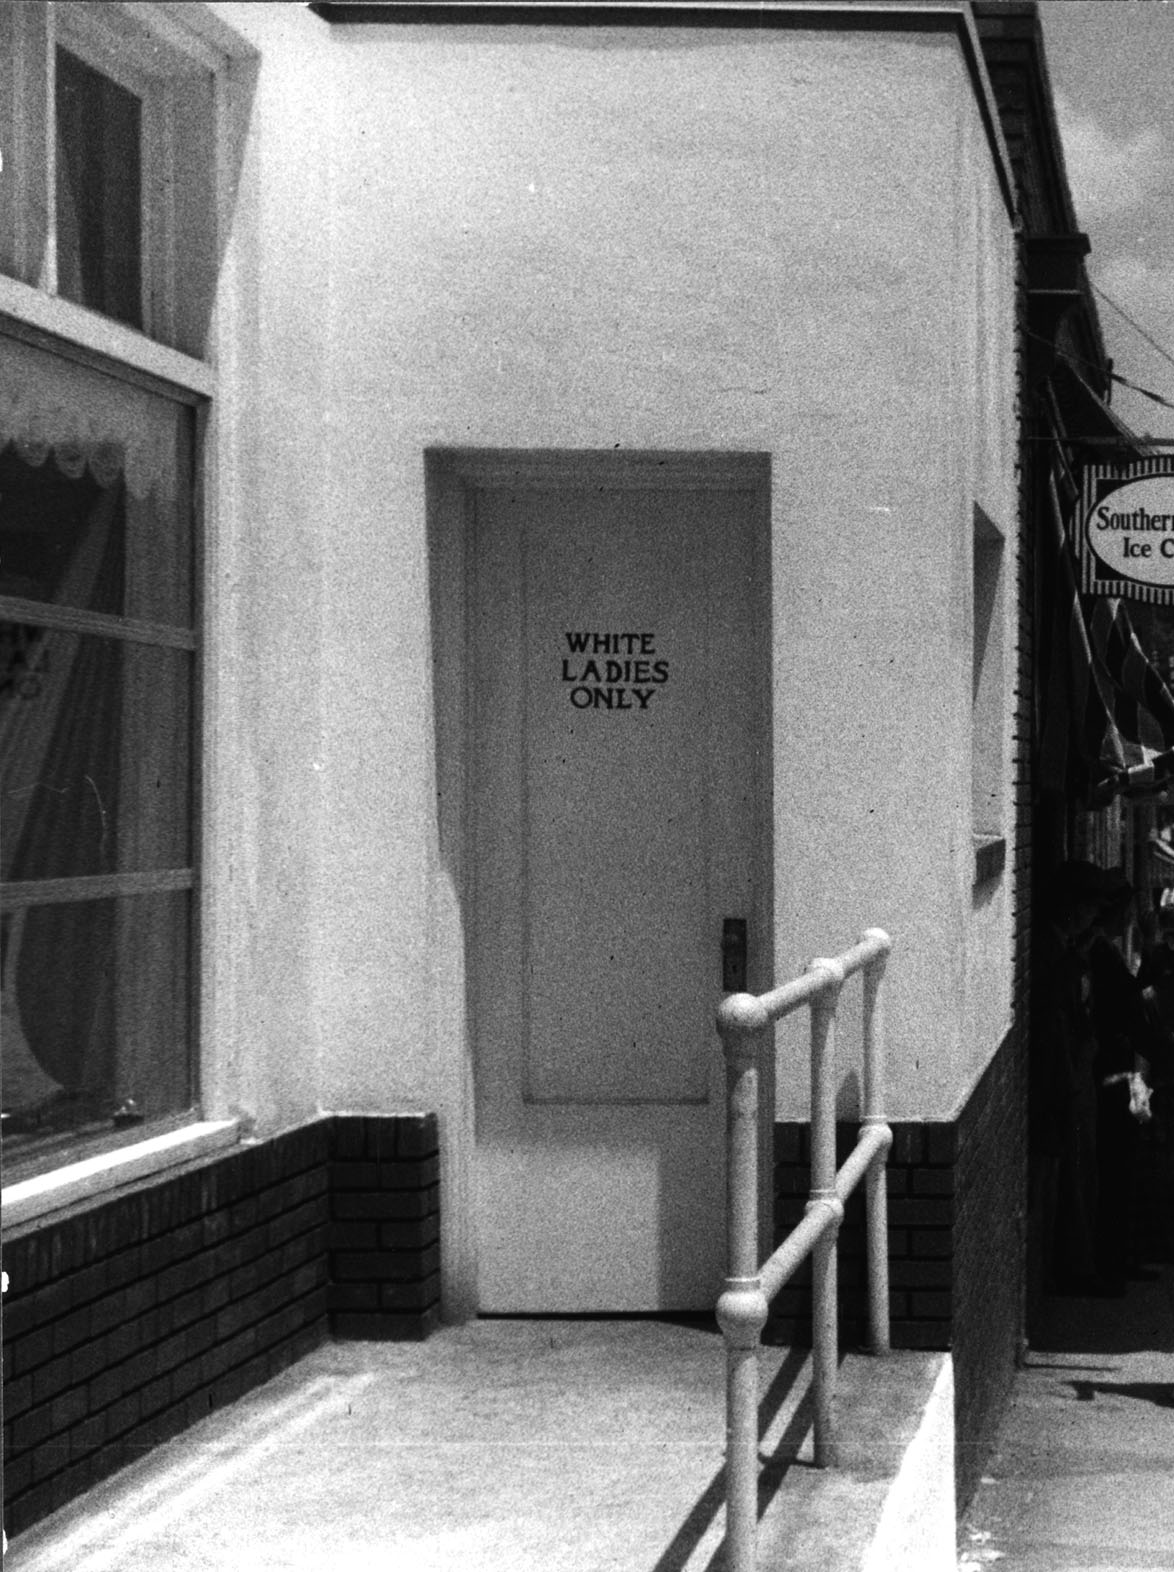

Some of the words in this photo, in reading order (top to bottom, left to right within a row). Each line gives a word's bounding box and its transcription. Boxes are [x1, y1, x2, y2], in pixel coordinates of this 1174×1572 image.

[1122, 537, 1152, 558] Ice
[565, 632, 656, 654] WHITE
[562, 659, 669, 683] LADIES
[570, 686, 656, 709] ONLY
